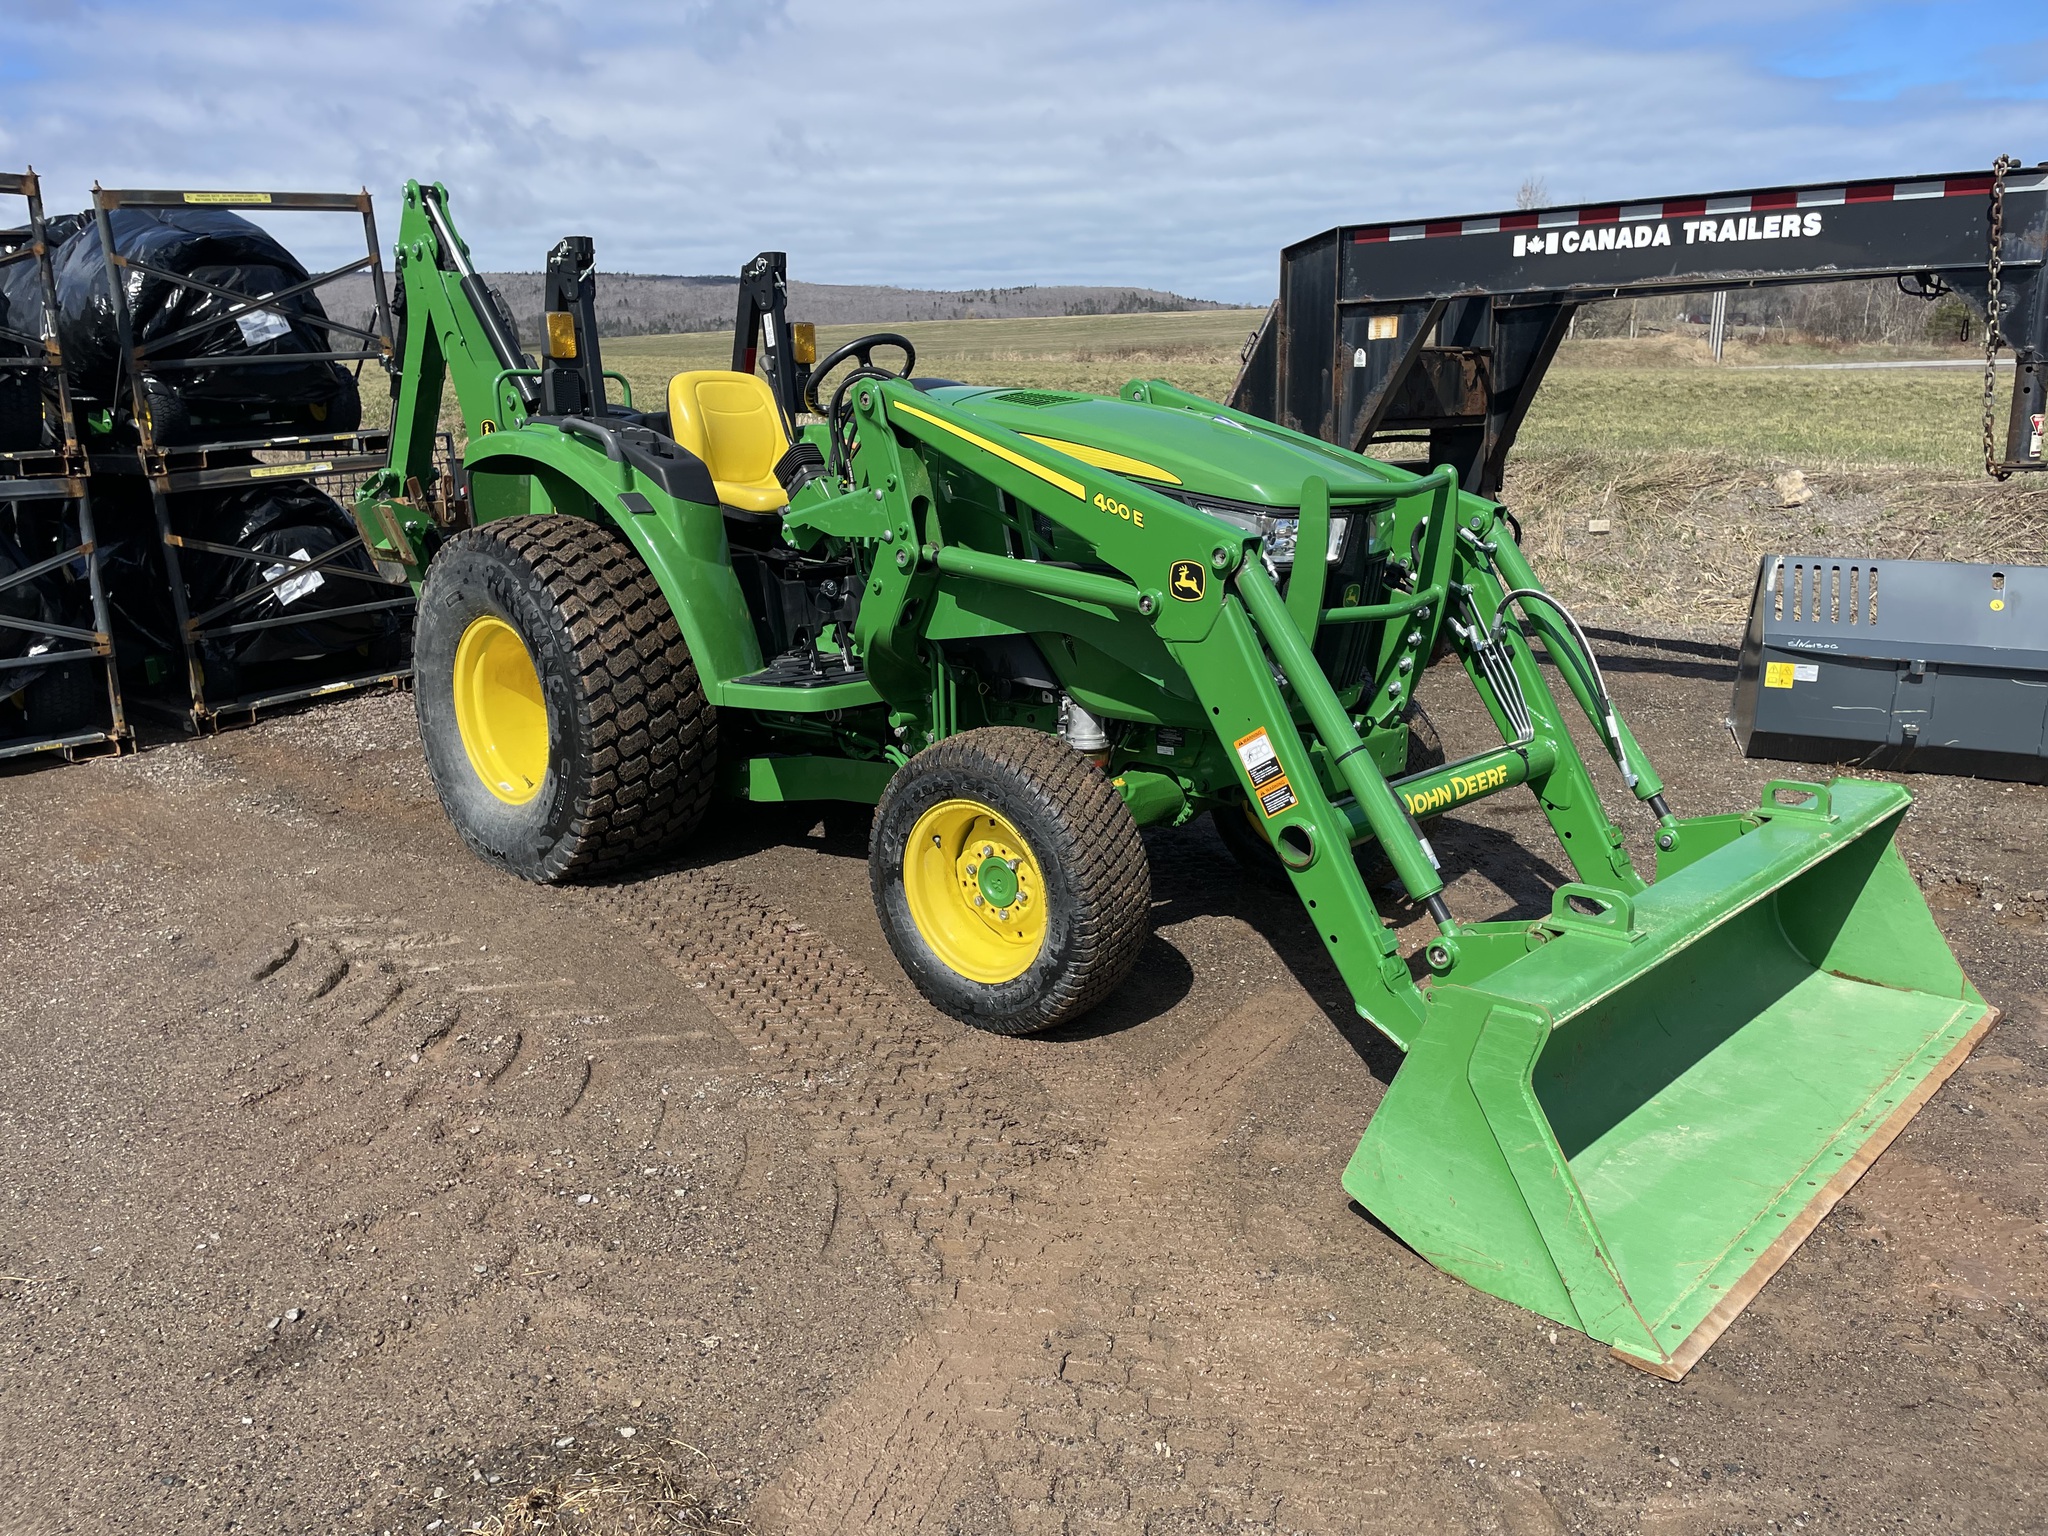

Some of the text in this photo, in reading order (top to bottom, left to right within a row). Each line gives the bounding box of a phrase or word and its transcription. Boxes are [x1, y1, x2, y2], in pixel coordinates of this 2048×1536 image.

[1562, 212, 1822, 253] CANADA TRAILERS
[1093, 492, 1144, 529] 400 E
[1404, 784, 1452, 816] JOHN
